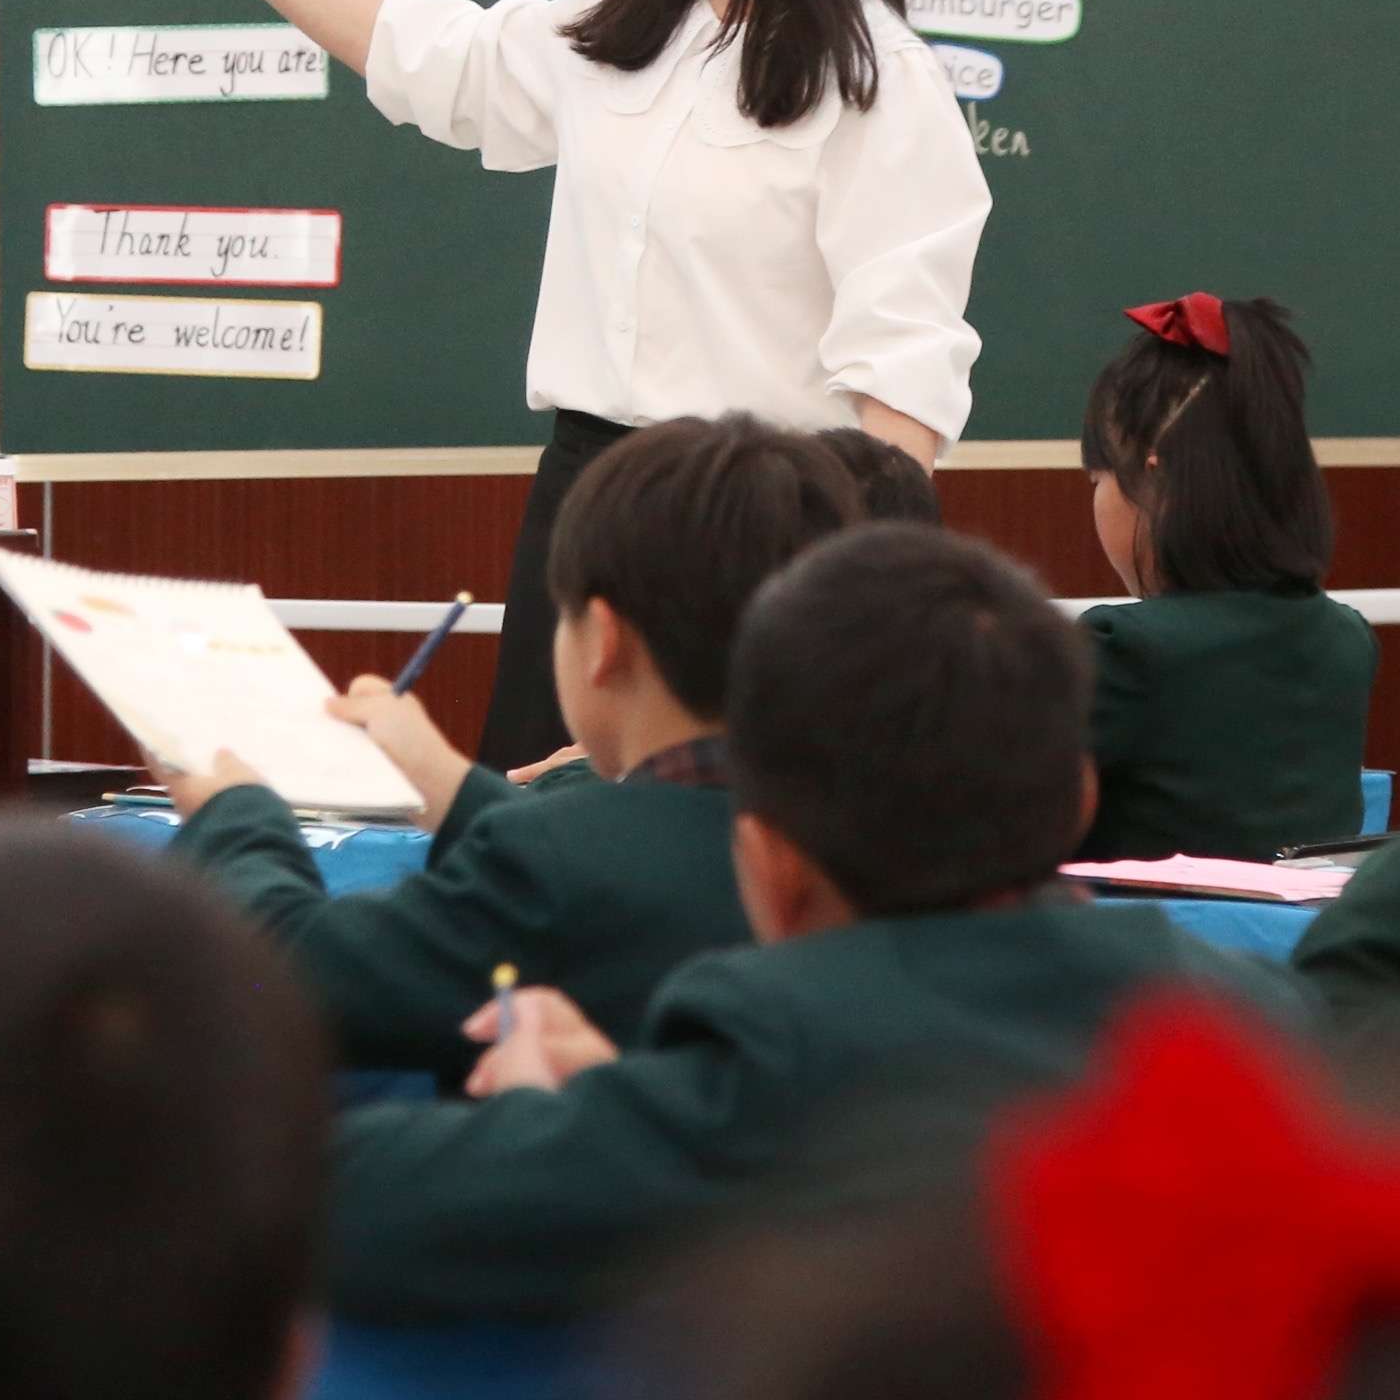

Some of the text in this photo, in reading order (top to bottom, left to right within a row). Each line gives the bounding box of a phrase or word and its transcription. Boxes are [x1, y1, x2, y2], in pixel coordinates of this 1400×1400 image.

[127, 33, 208, 77] Here
[219, 48, 265, 97] you
[93, 209, 193, 258] Thank
[55, 297, 310, 352] You're welcome!
